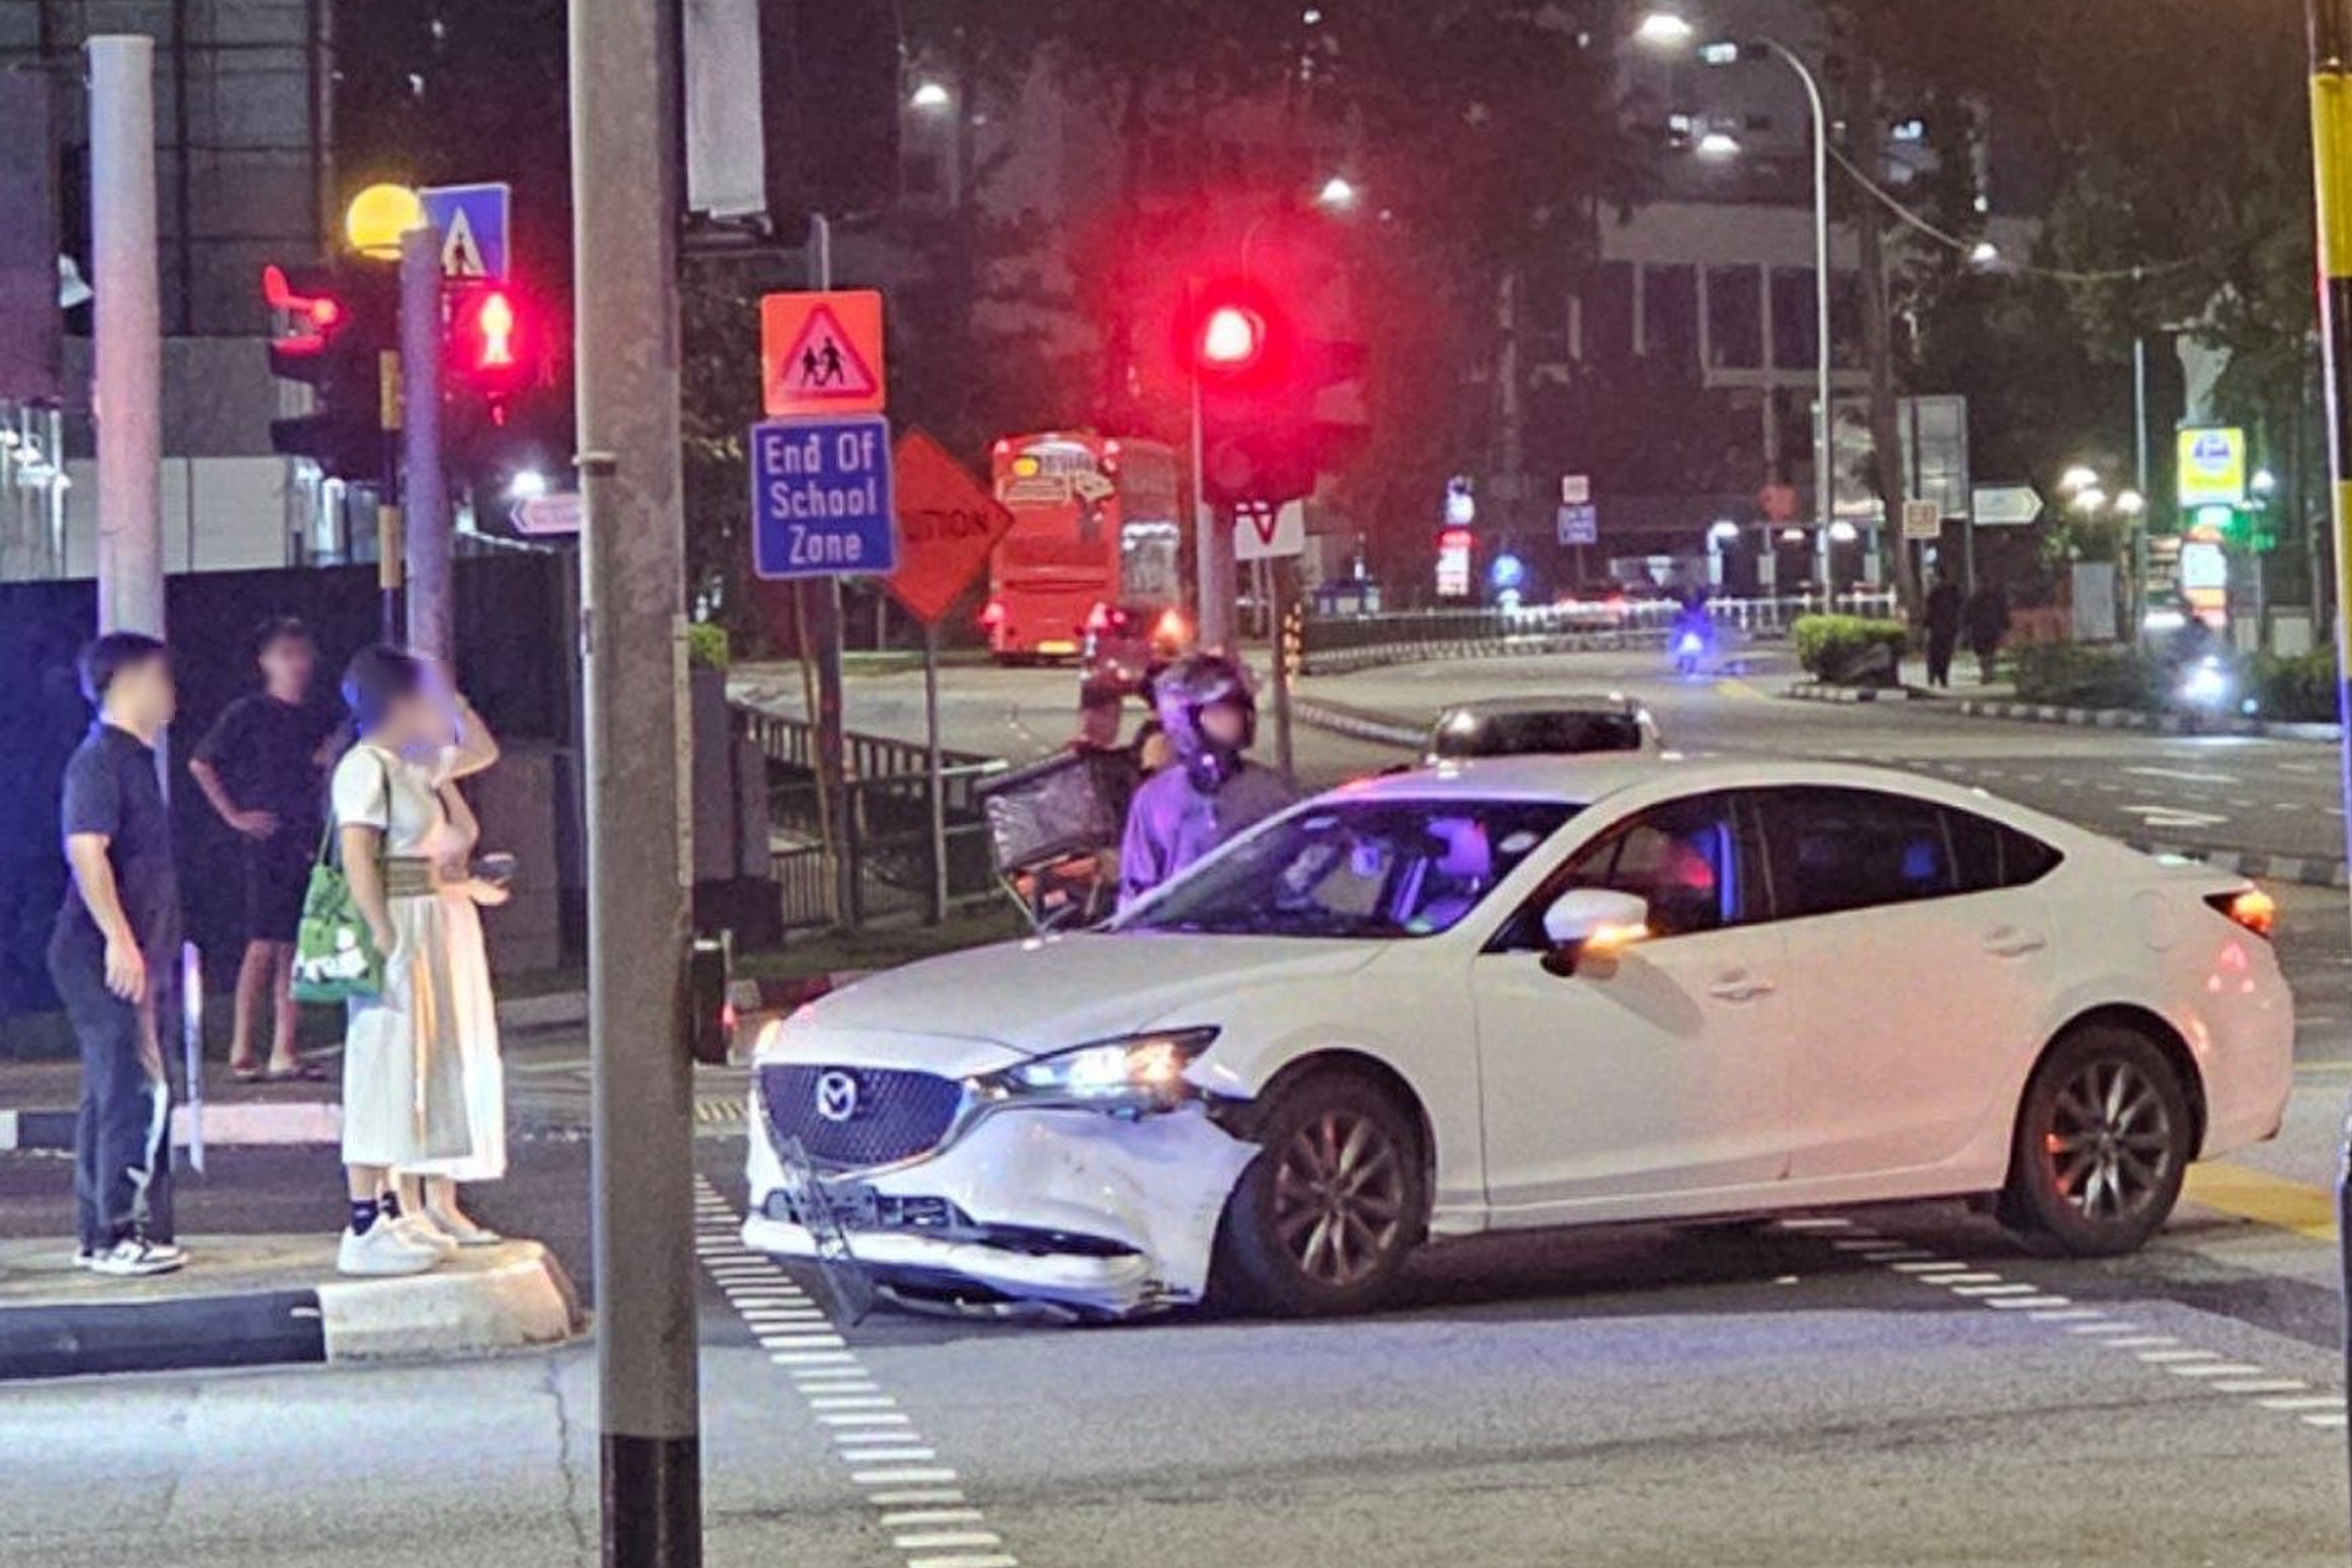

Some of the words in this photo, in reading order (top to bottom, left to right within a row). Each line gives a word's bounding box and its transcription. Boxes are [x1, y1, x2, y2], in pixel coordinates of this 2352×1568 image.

[765, 434, 820, 474] End
[838, 431, 874, 470] Of
[770, 477, 877, 518] School
[789, 524, 862, 564] Zone
